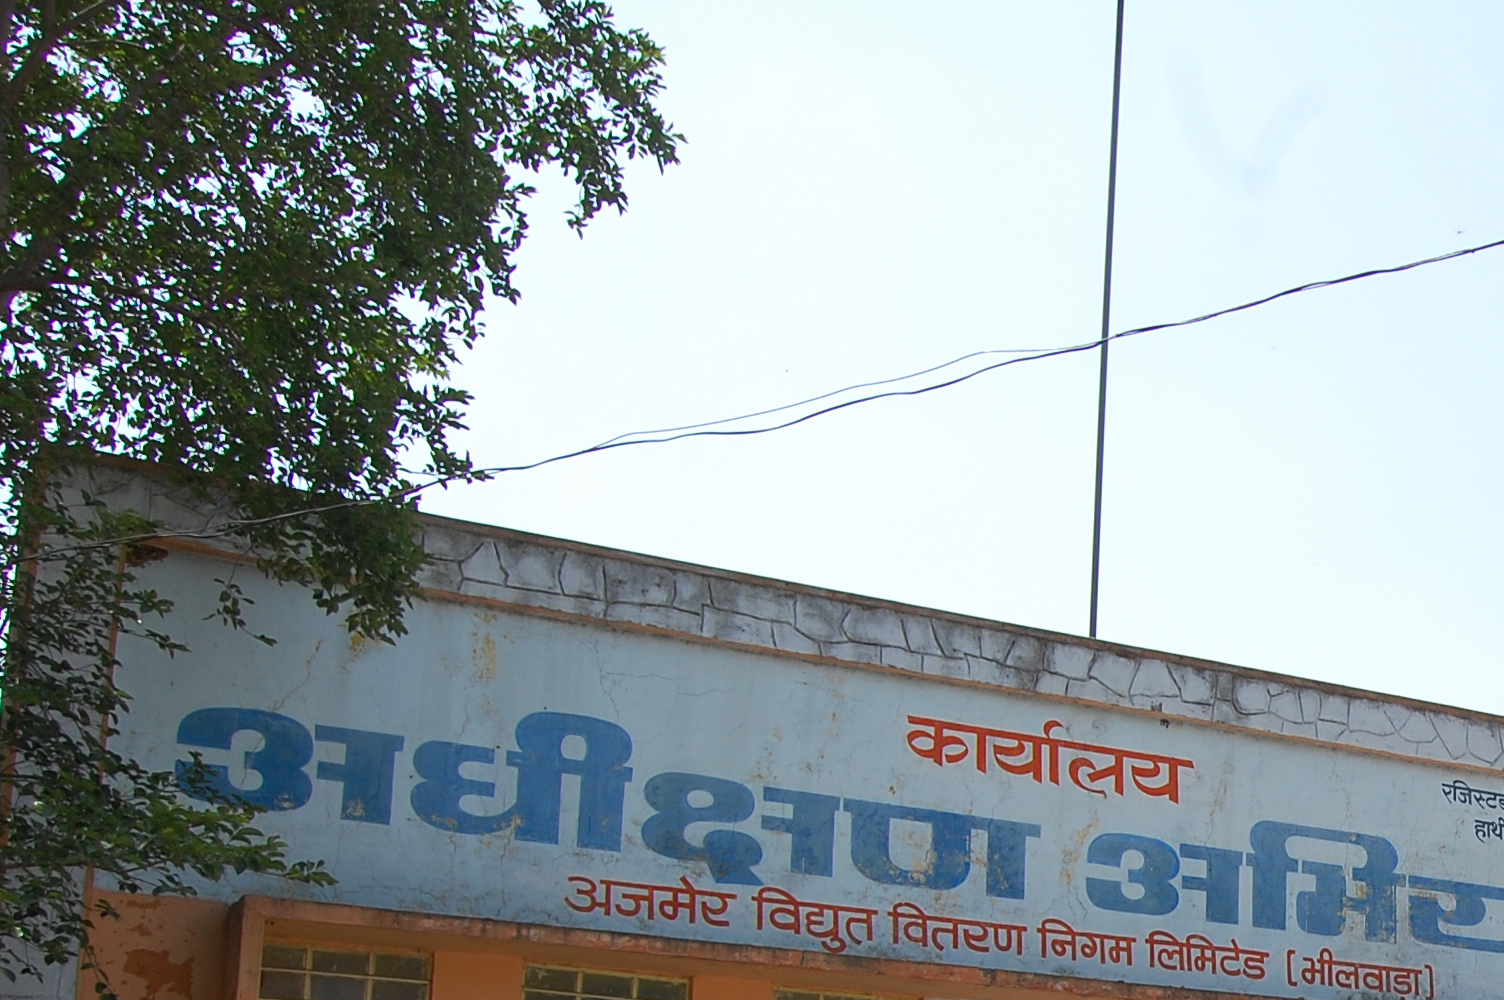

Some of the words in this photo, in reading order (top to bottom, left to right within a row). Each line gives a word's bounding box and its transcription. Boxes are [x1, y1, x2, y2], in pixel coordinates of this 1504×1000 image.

[175, 706, 1041, 900] अधीक्षण
[906, 715, 1194, 805] कार्यालय
[563, 875, 738, 929] अजमेर
[751, 886, 879, 955] विद्युत
[888, 902, 1028, 956] वितरण
[1037, 918, 1137, 967] निगम
[1145, 930, 1270, 980] लिमिटेड
